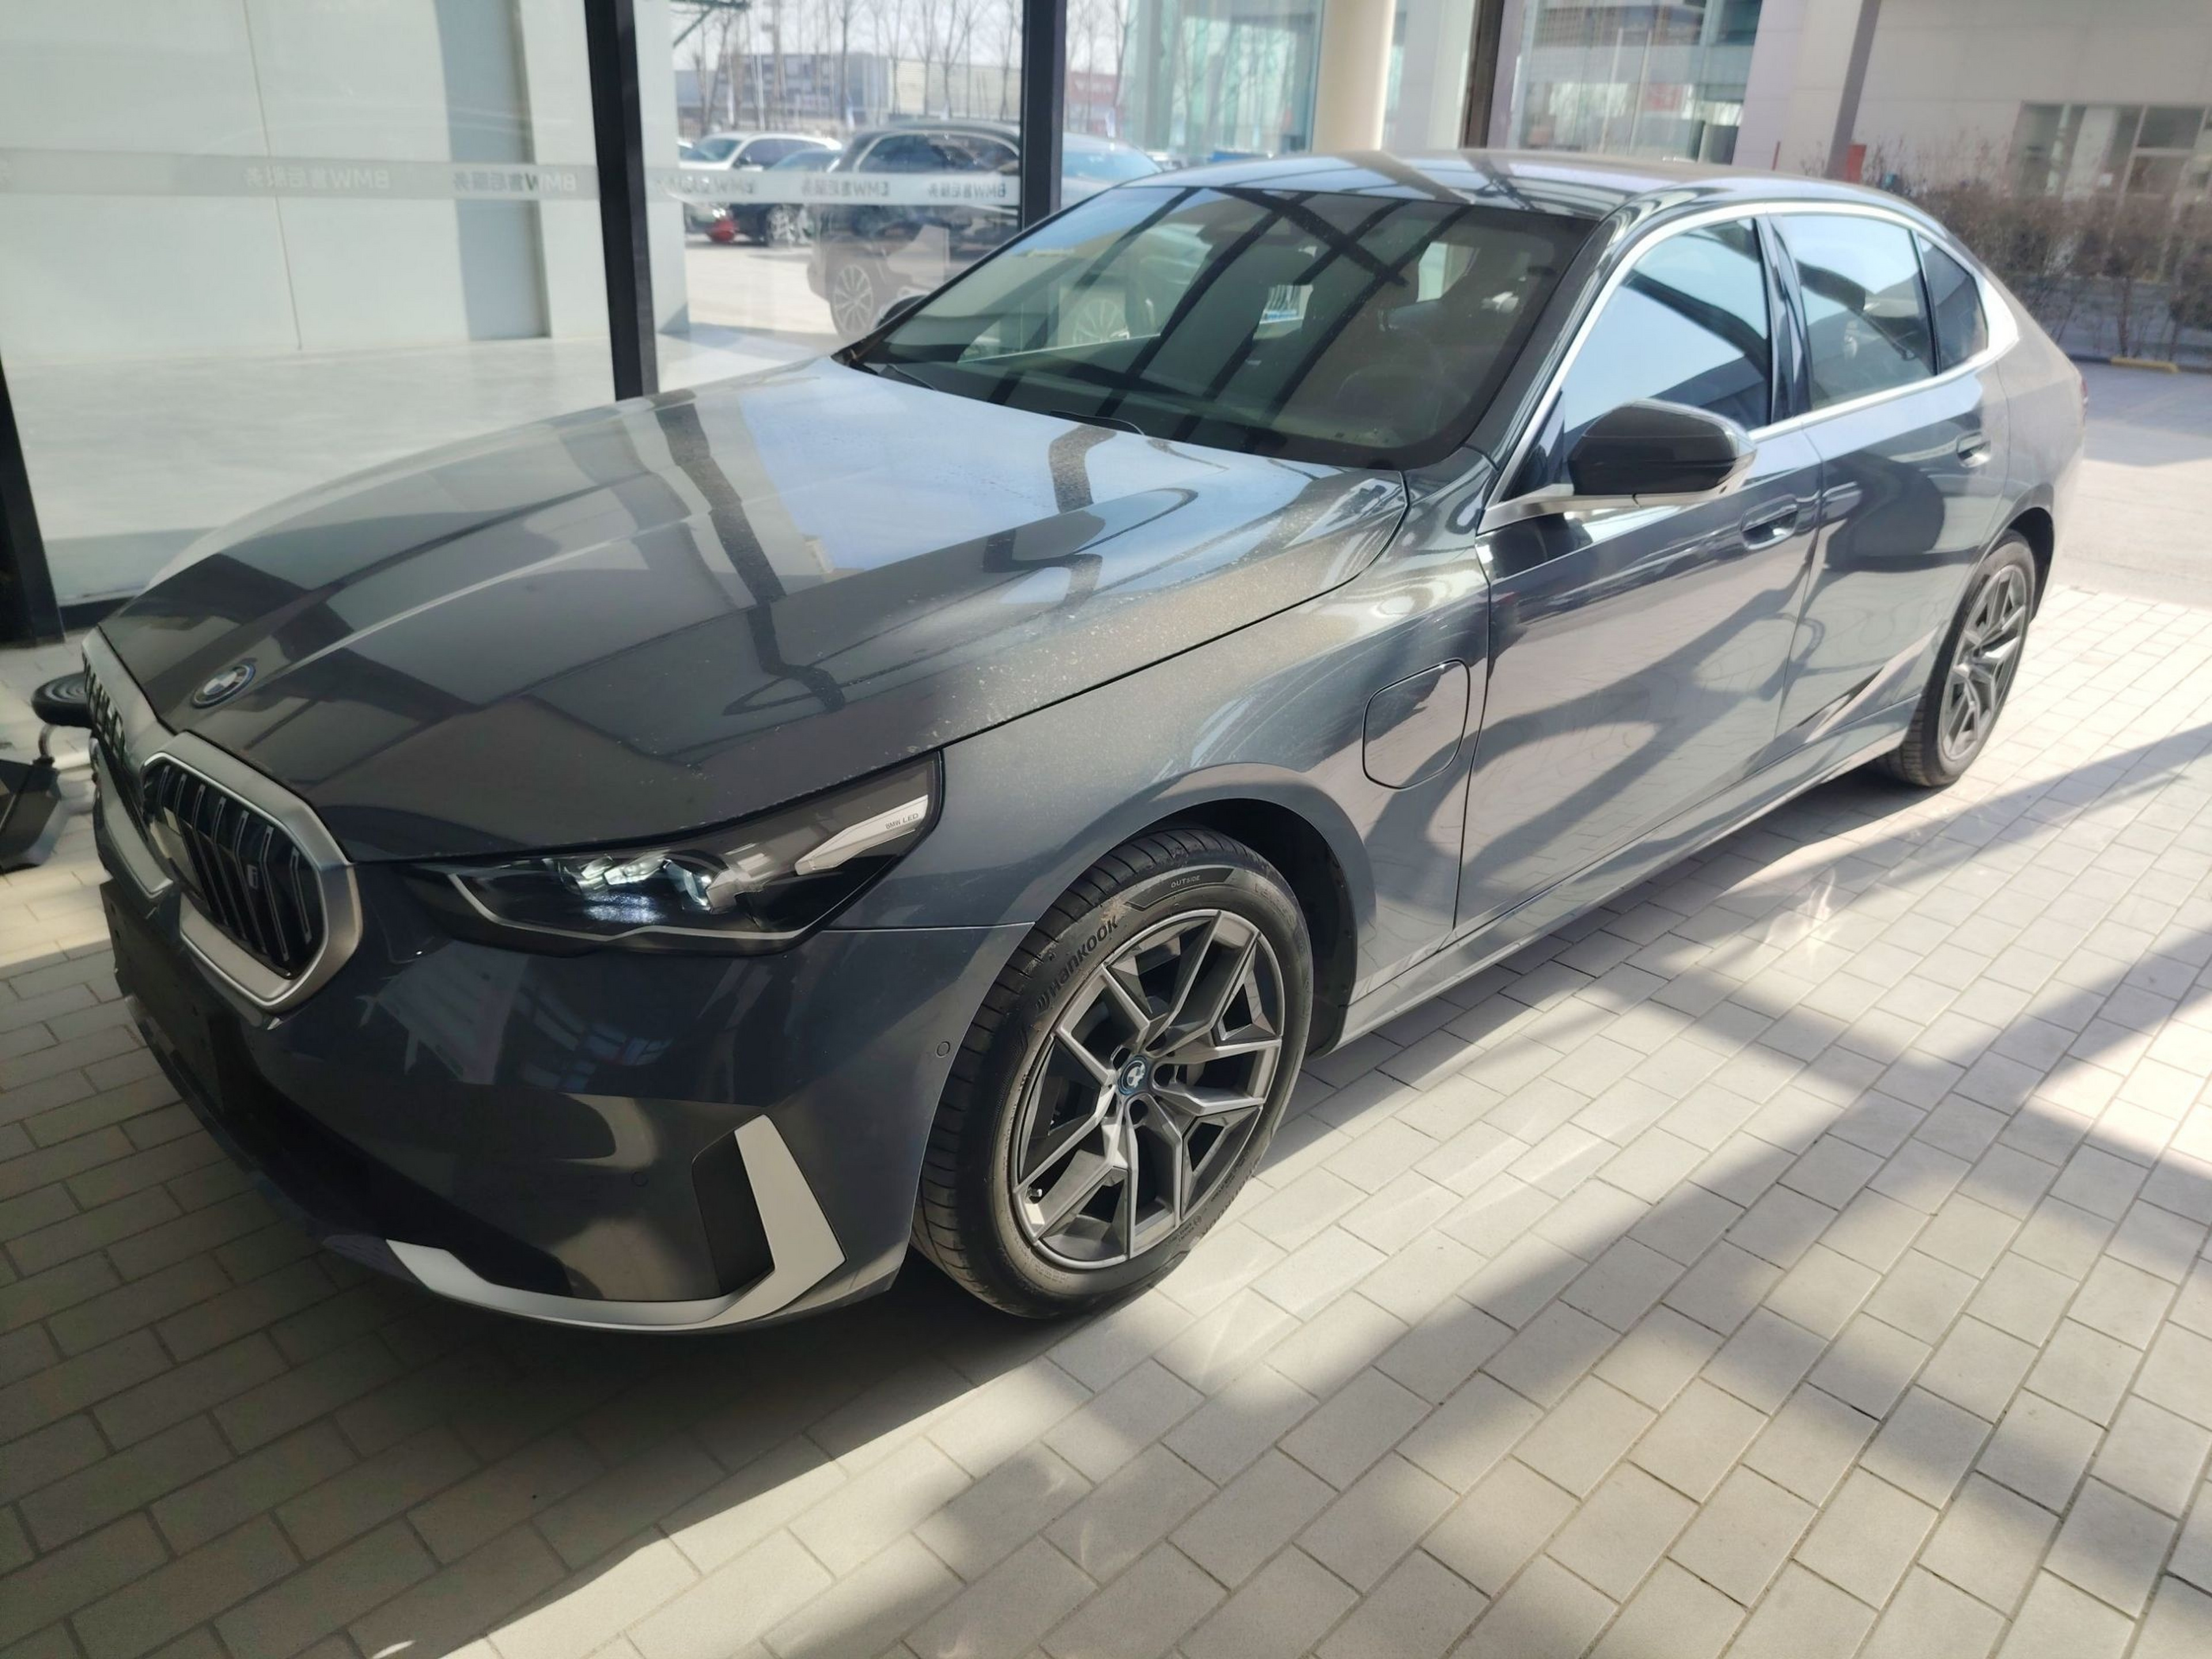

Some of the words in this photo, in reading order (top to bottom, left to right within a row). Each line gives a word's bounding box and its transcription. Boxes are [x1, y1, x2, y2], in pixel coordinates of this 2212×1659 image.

[885, 819, 900, 829] BMW
[903, 813, 919, 823] LED
[1171, 875, 1200, 888] OUTSIDE
